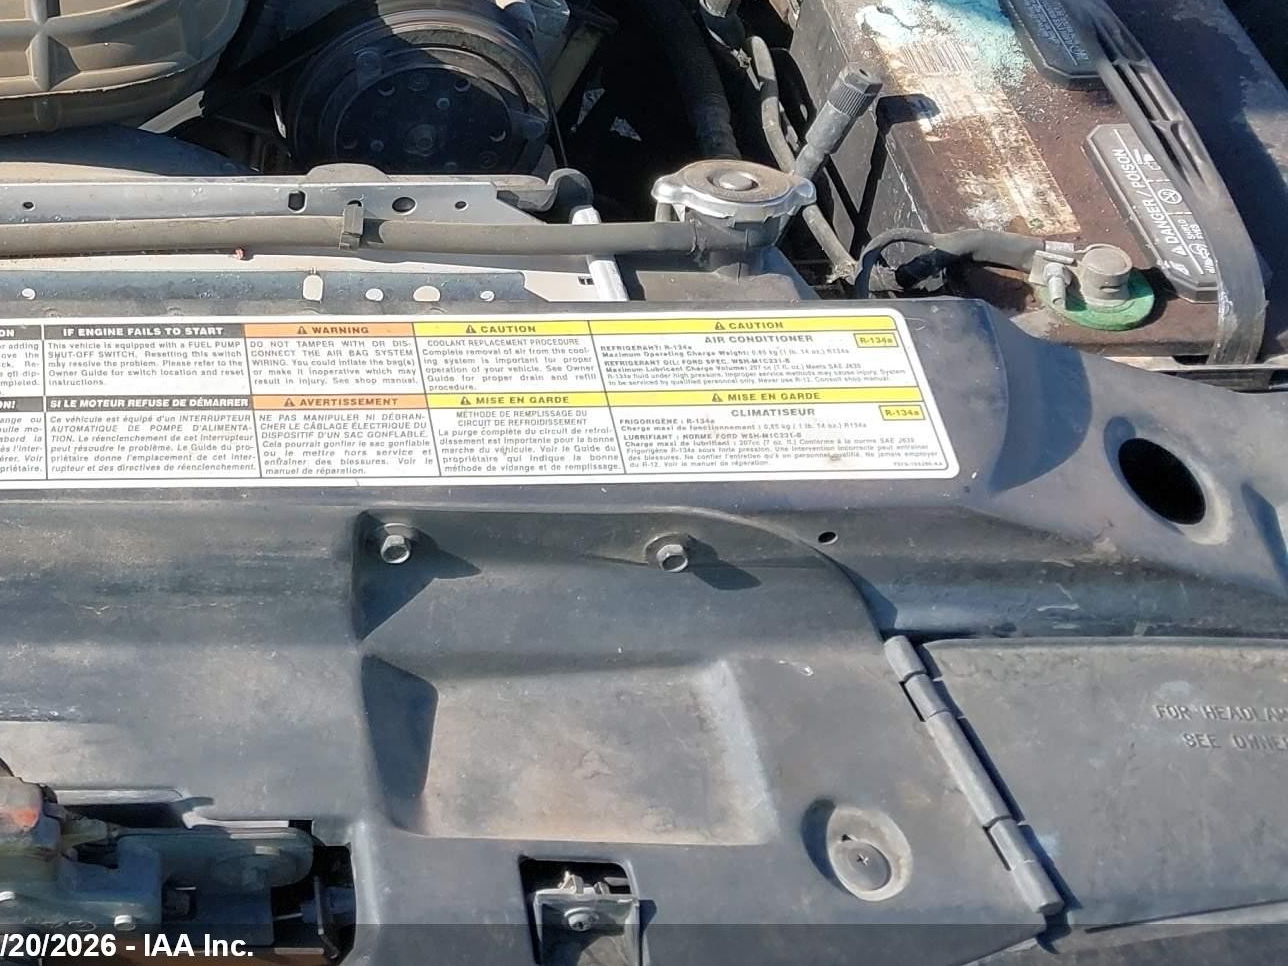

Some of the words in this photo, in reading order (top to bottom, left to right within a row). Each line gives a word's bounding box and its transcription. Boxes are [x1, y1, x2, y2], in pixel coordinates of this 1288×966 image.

[1112, 149, 1146, 189] POISON
[1143, 199, 1180, 244] DANGER
[480, 325, 536, 333] CAUTION
[728, 321, 784, 329] CAUTION
[63, 328, 74, 336] IF
[78, 327, 123, 336] ENGINE
[128, 327, 161, 335] FAILS
[166, 327, 181, 335] TO
[185, 326, 222, 335] START
[312, 326, 369, 334] WARNING
[427, 339, 466, 347] COOLANT
[468, 338, 528, 346] REPLACEMENT
[529, 338, 580, 346] PROCEDURE
[728, 334, 814, 343] CONDITIONER
[8, 342, 39, 351] adding
[69, 341, 101, 349] vehicle
[115, 341, 156, 350] equipped
[188, 340, 212, 348] FUEL
[215, 340, 241, 348] PUMP
[249, 340, 264, 348] DO
[270, 340, 289, 348] NOT
[392, 339, 412, 347] DIS-
[250, 349, 296, 357] CONNECT
[326, 349, 343, 357] AIR
[348, 349, 369, 357] BAG
[374, 348, 414, 356] SYSTEM
[22, 370, 40, 378] dip-
[48, 378, 104, 386] instructions.
[428, 383, 477, 391] procedure.
[475, 396, 506, 404] MISE
[508, 396, 525, 404] EN
[727, 393, 757, 401] MISE
[780, 392, 821, 400] GARDE
[50, 399, 61, 408] SI
[64, 399, 77, 407] LE
[80, 399, 125, 407] MOTEUR
[128, 398, 170, 407] REFUSE
[172, 398, 186, 406] DE
[189, 397, 248, 406] DÉMARRER
[299, 397, 399, 406] AVERTISSEMENT
[513, 409, 573, 417] REMPLISSAGE
[730, 407, 816, 417] CLIMATISEUR
[278, 413, 297, 422] PAS
[303, 413, 360, 422] MANIPULER
[365, 413, 376, 421] NI
[457, 419, 491, 427] CIRCUIT
[507, 417, 587, 426] REFROIDISSEMENT
[260, 422, 286, 430] CHER
[288, 422, 301, 430] LE
[413, 421, 427, 429] DU
[1152, 705, 1191, 721] FOR
[1182, 733, 1222, 749] SEE
